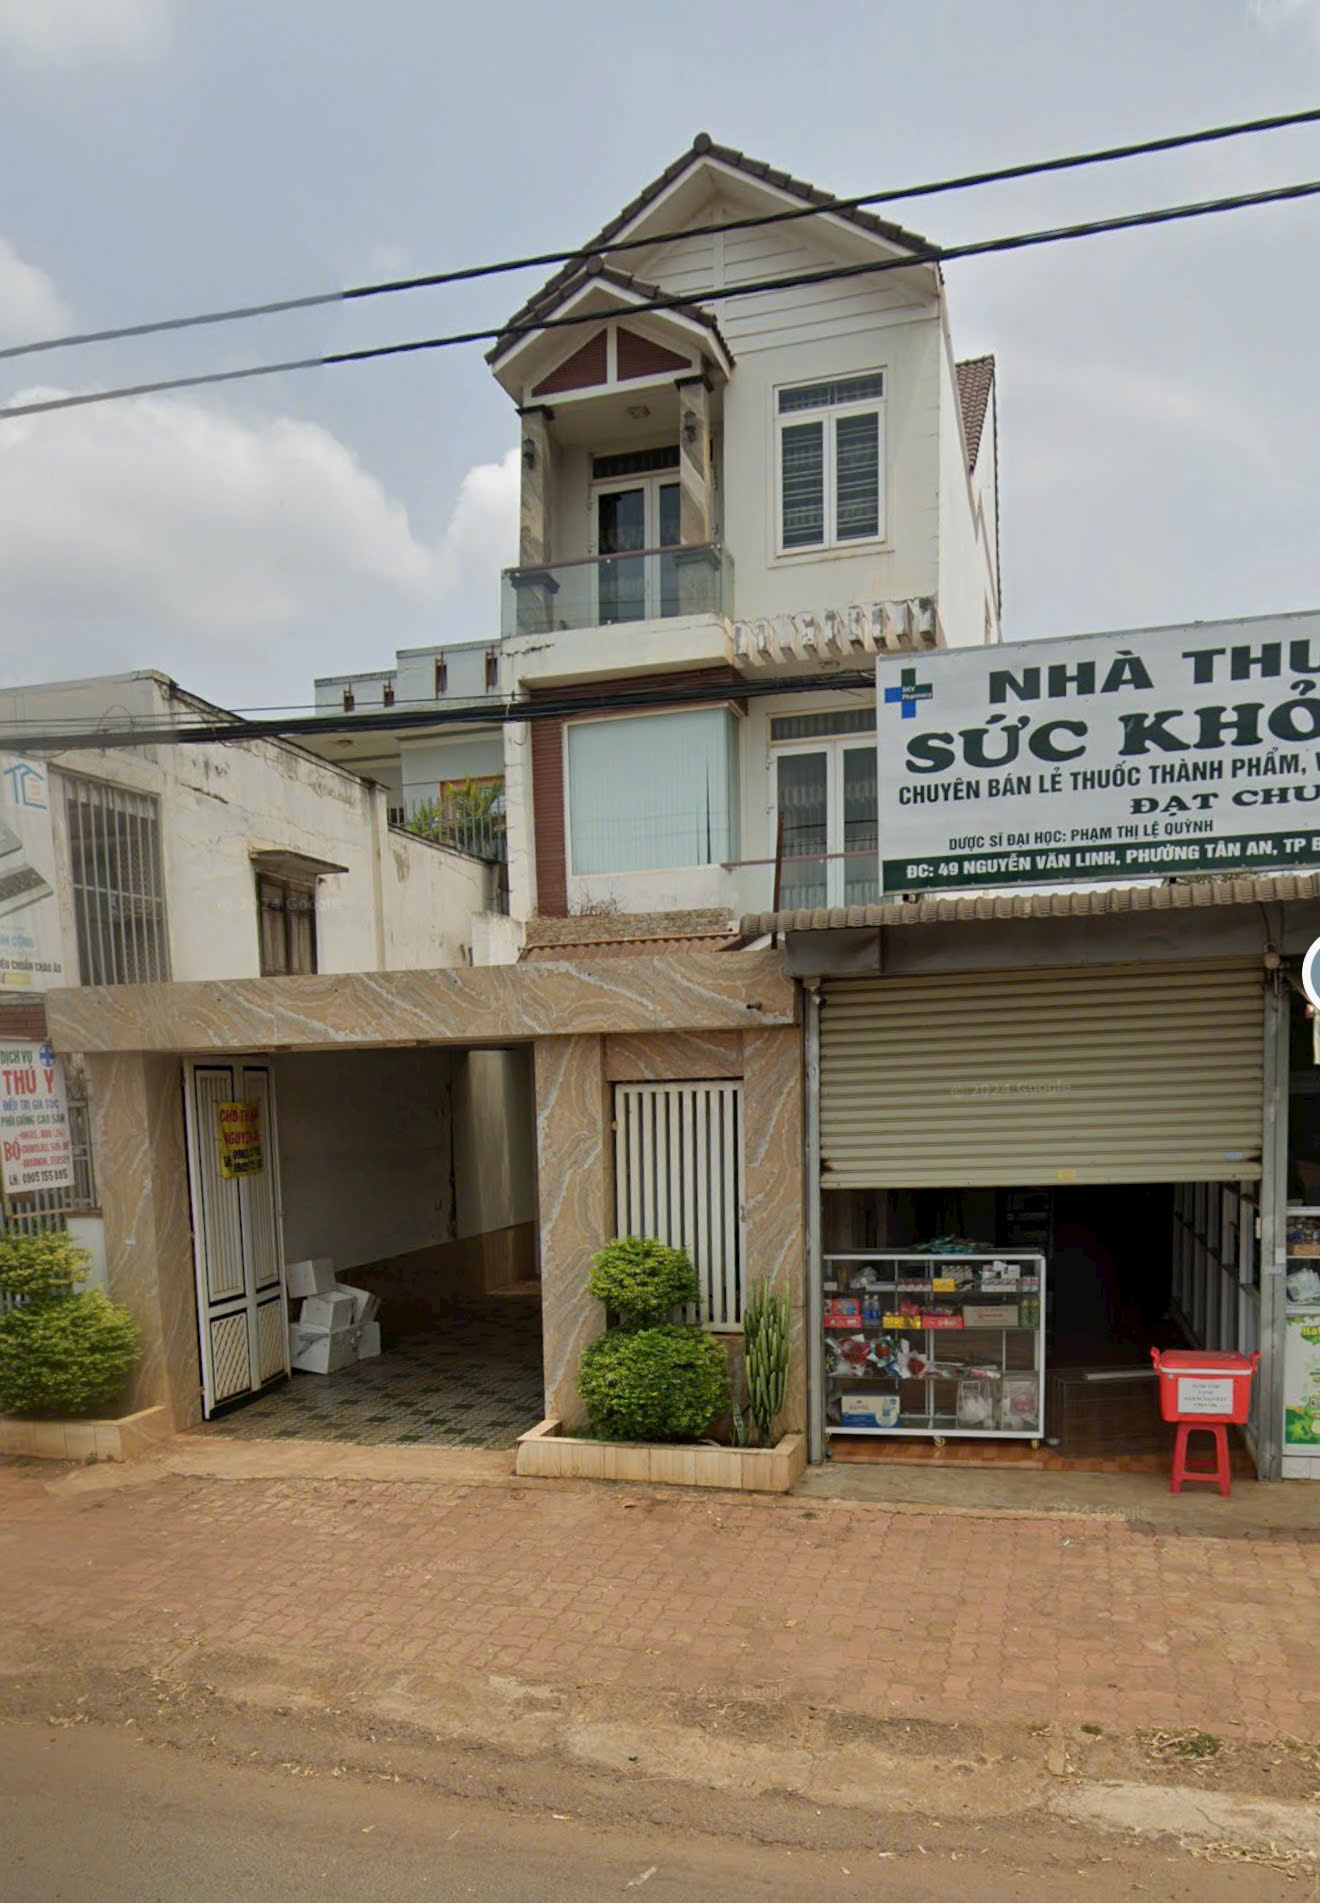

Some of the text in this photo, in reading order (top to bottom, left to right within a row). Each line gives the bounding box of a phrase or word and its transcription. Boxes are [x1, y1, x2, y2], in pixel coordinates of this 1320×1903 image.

[989, 650, 1154, 704] NHÀ
[905, 679, 1320, 774] SỨC KHỎ
[898, 777, 980, 805] CHUYÊN
[988, 773, 1031, 798] BÁN
[1039, 767, 1062, 793] LẺ
[1069, 760, 1141, 790] THUỐC
[1149, 759, 1223, 785] THÀNH
[1231, 747, 1306, 778] PHẨM,
[1130, 792, 1219, 816] ĐẠT
[949, 836, 985, 851] DƯỢC
[1007, 833, 1029, 848] ĐẠI
[1034, 830, 1066, 847] HỌC:
[1071, 827, 1111, 843] PHẠM
[1117, 824, 1138, 840] THỊ
[1144, 821, 1159, 839] LỆ
[1165, 818, 1213, 835] QUỲNH
[906, 864, 934, 879] ĐC:
[938, 862, 959, 876] 49
[963, 853, 1031, 874] NGUYỄN
[1036, 852, 1071, 870] VĂN
[1076, 850, 1120, 867] LINH,
[1126, 843, 1200, 864] PHƯỜNG
[1204, 840, 1240, 858] TÂN
[1246, 840, 1278, 856] AN,
[1283, 838, 1306, 853] TP
[3, 1065, 53, 1095] THÚ Y
